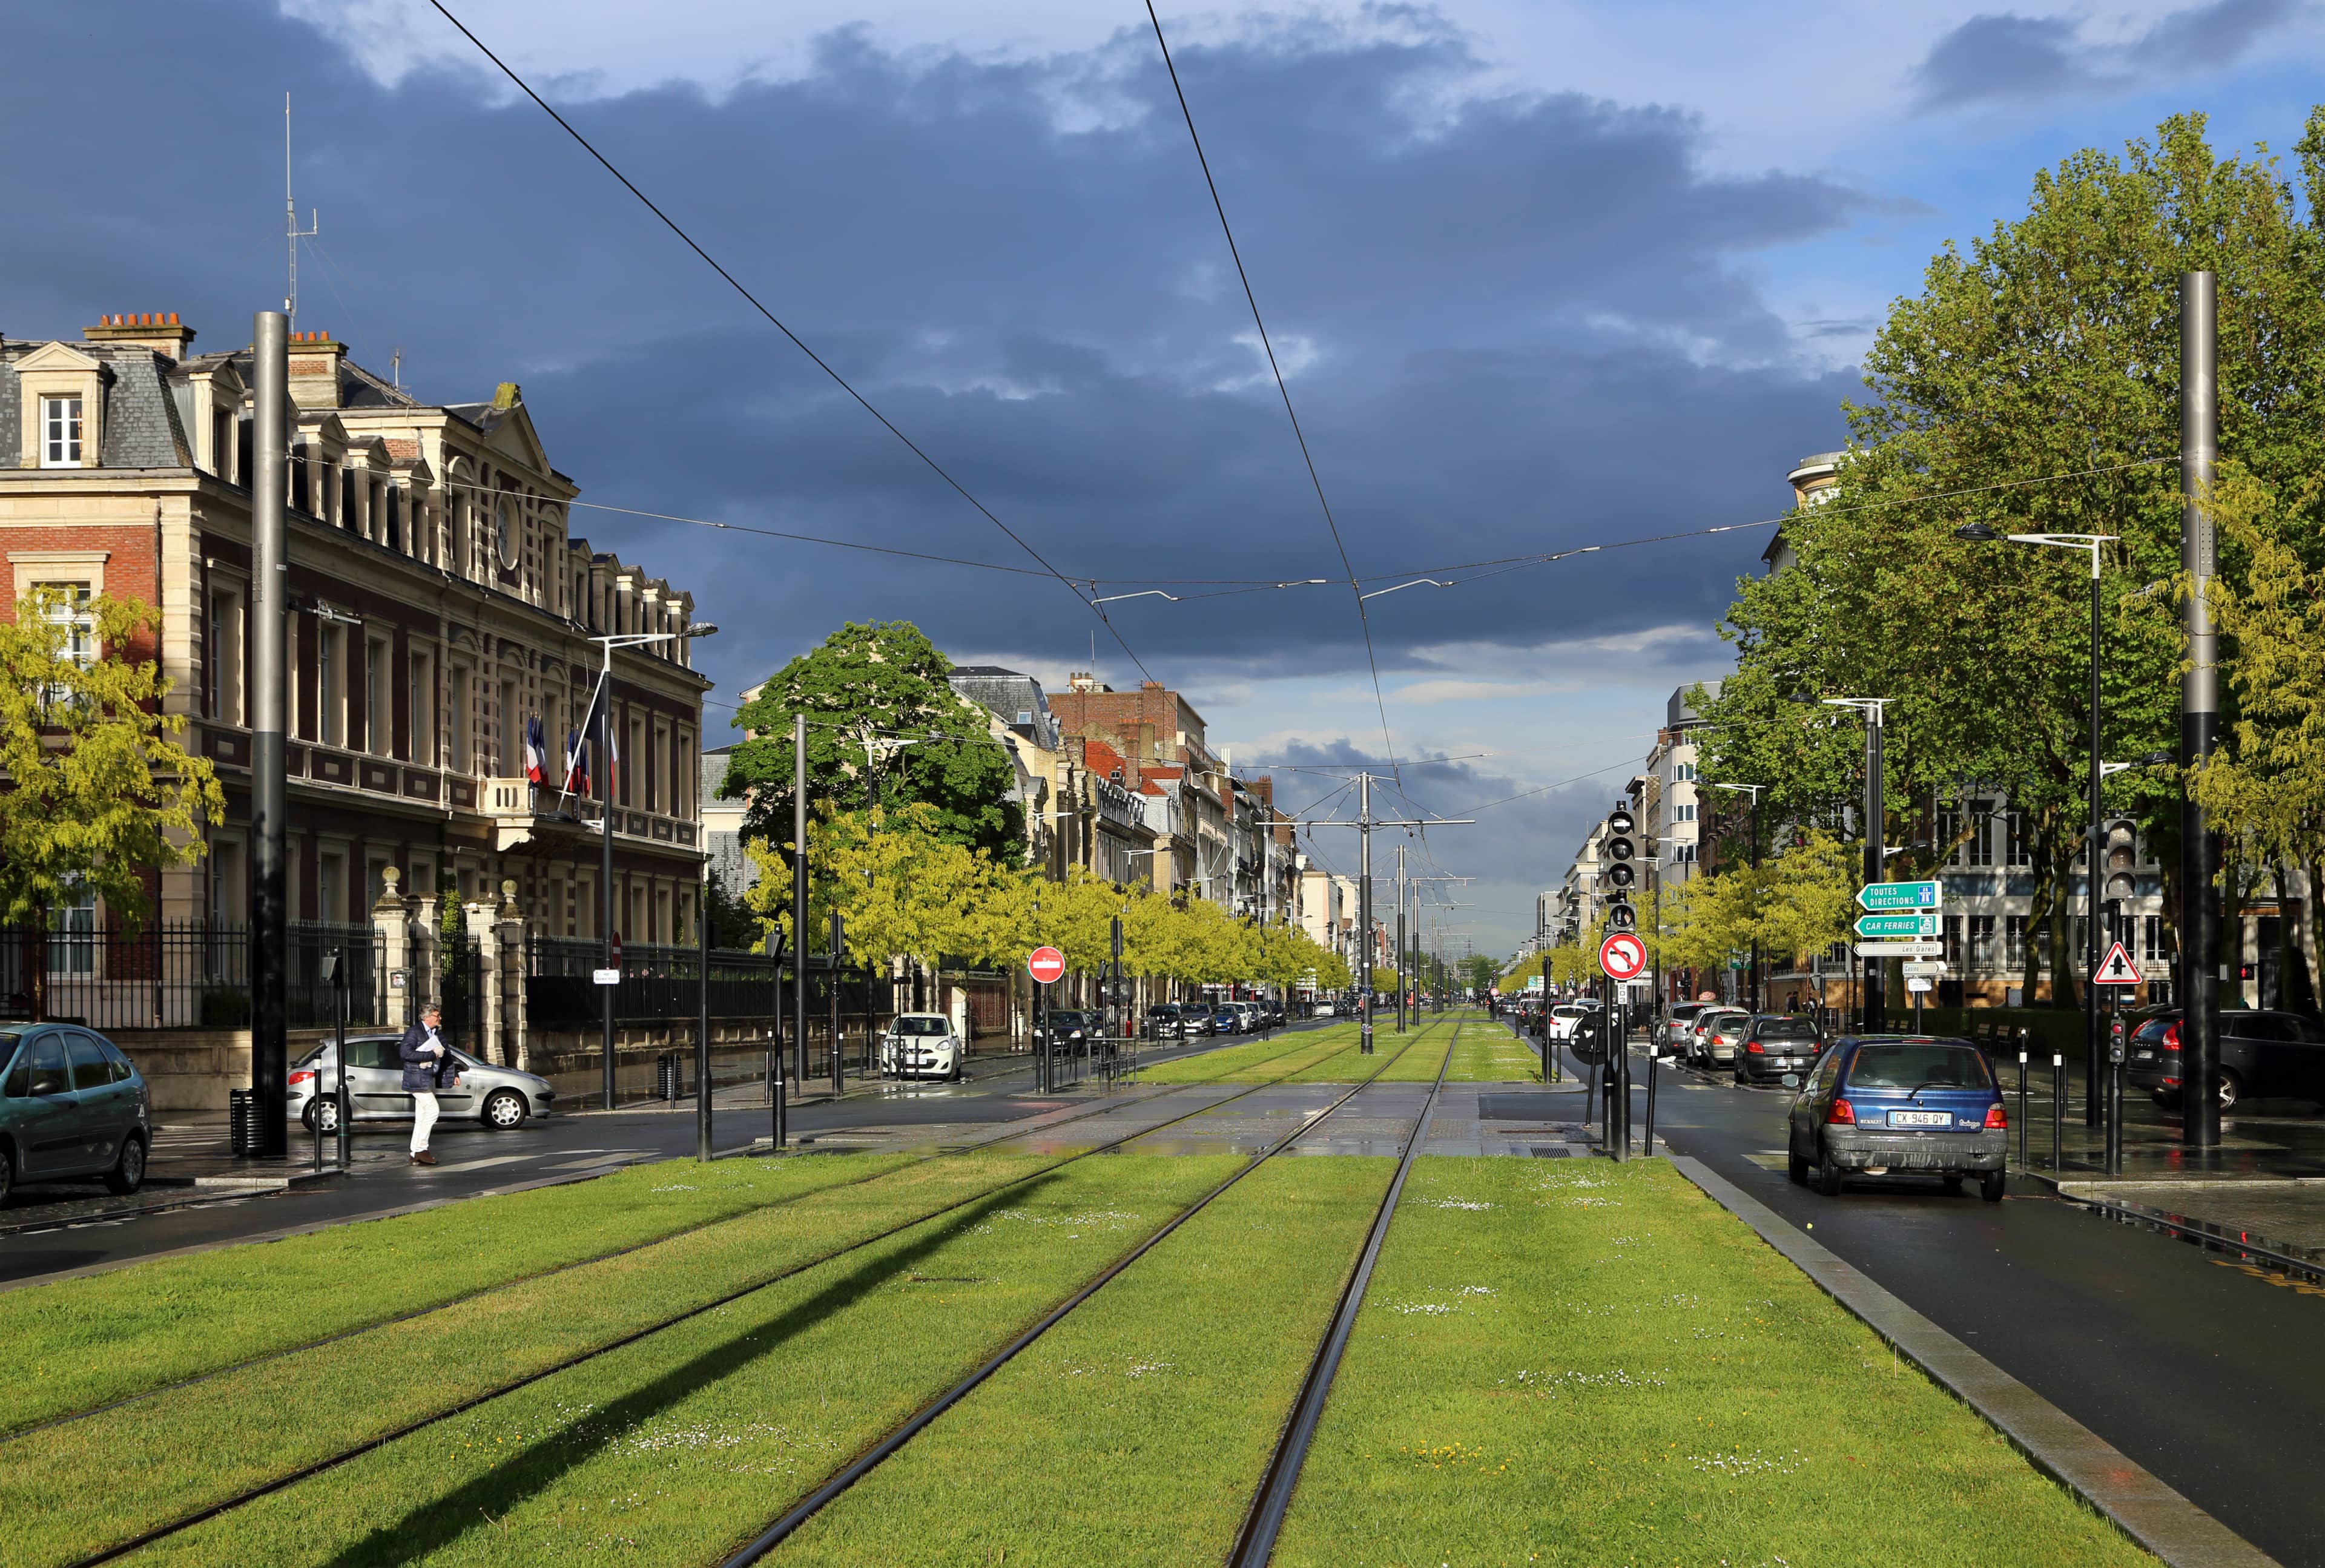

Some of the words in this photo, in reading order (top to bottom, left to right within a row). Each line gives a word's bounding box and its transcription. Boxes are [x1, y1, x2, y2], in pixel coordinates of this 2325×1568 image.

[1870, 888, 1897, 896] TOUTES
[1870, 897, 1914, 906] DIRECTIONS
[1884, 921, 1914, 930] FERRIES
